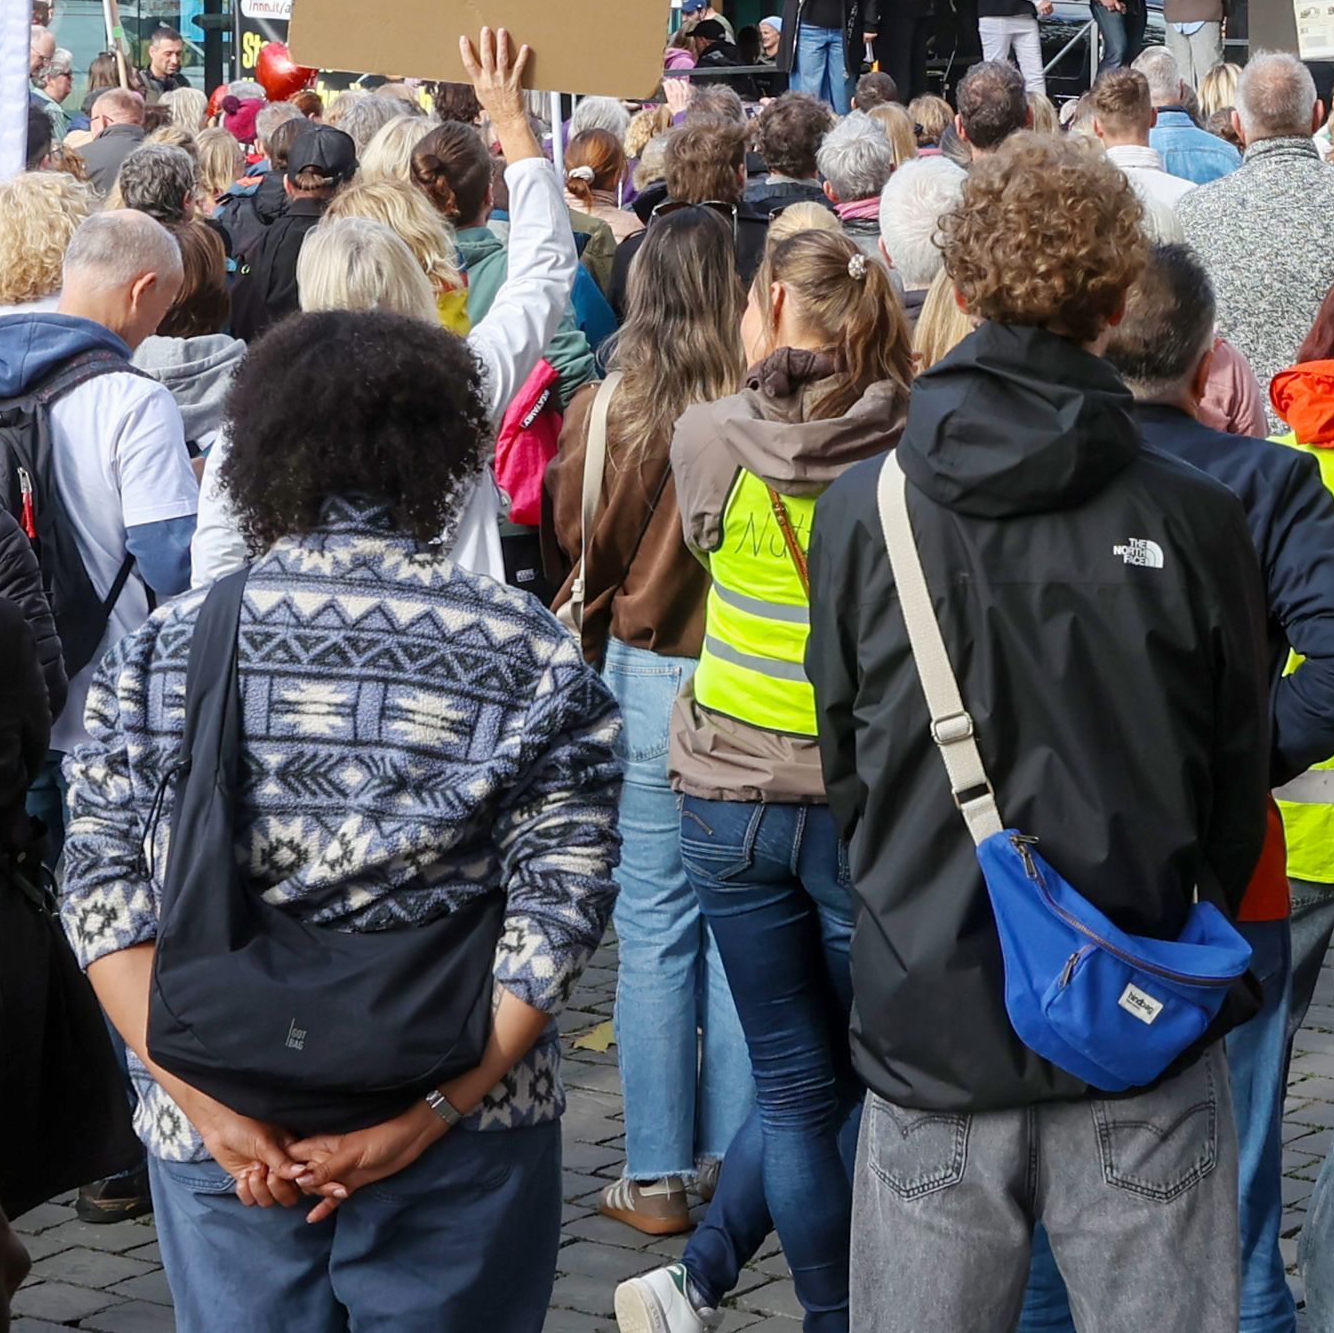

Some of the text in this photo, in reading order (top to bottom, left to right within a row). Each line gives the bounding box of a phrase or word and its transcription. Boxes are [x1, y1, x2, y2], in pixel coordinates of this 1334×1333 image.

[1128, 538, 1147, 548] THE
[1113, 545, 1147, 556] NORTH
[1123, 554, 1147, 566] FACE
[291, 1028, 307, 1039] GOT
[289, 1037, 304, 1050] BAG
